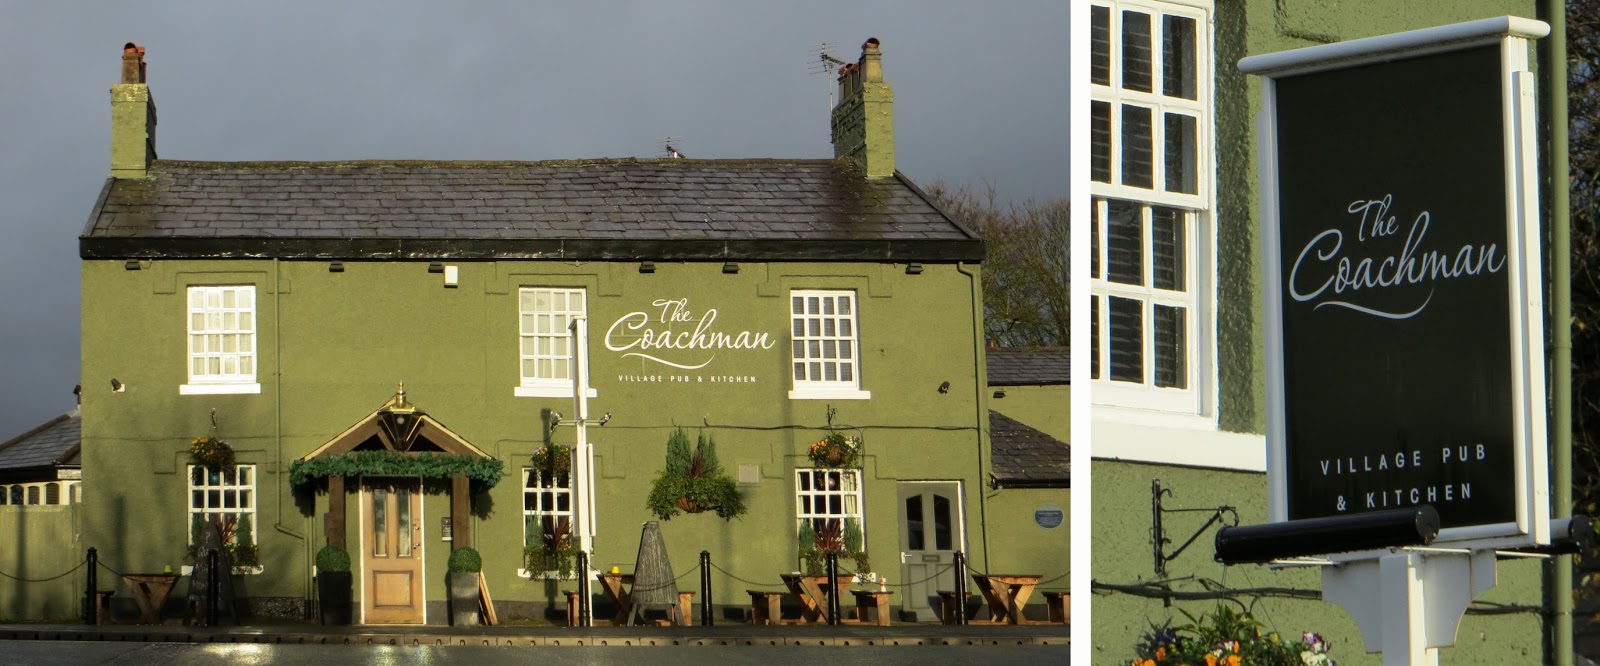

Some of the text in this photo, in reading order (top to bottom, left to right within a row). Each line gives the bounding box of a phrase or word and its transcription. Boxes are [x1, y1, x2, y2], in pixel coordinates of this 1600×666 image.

[1348, 193, 1400, 242] The
[1289, 211, 1506, 302] Coachman
[652, 298, 693, 323] The
[604, 308, 776, 352] Coachman
[1320, 444, 1485, 476] VILLAGE PUB
[1336, 482, 1471, 511] & KITCHEN
